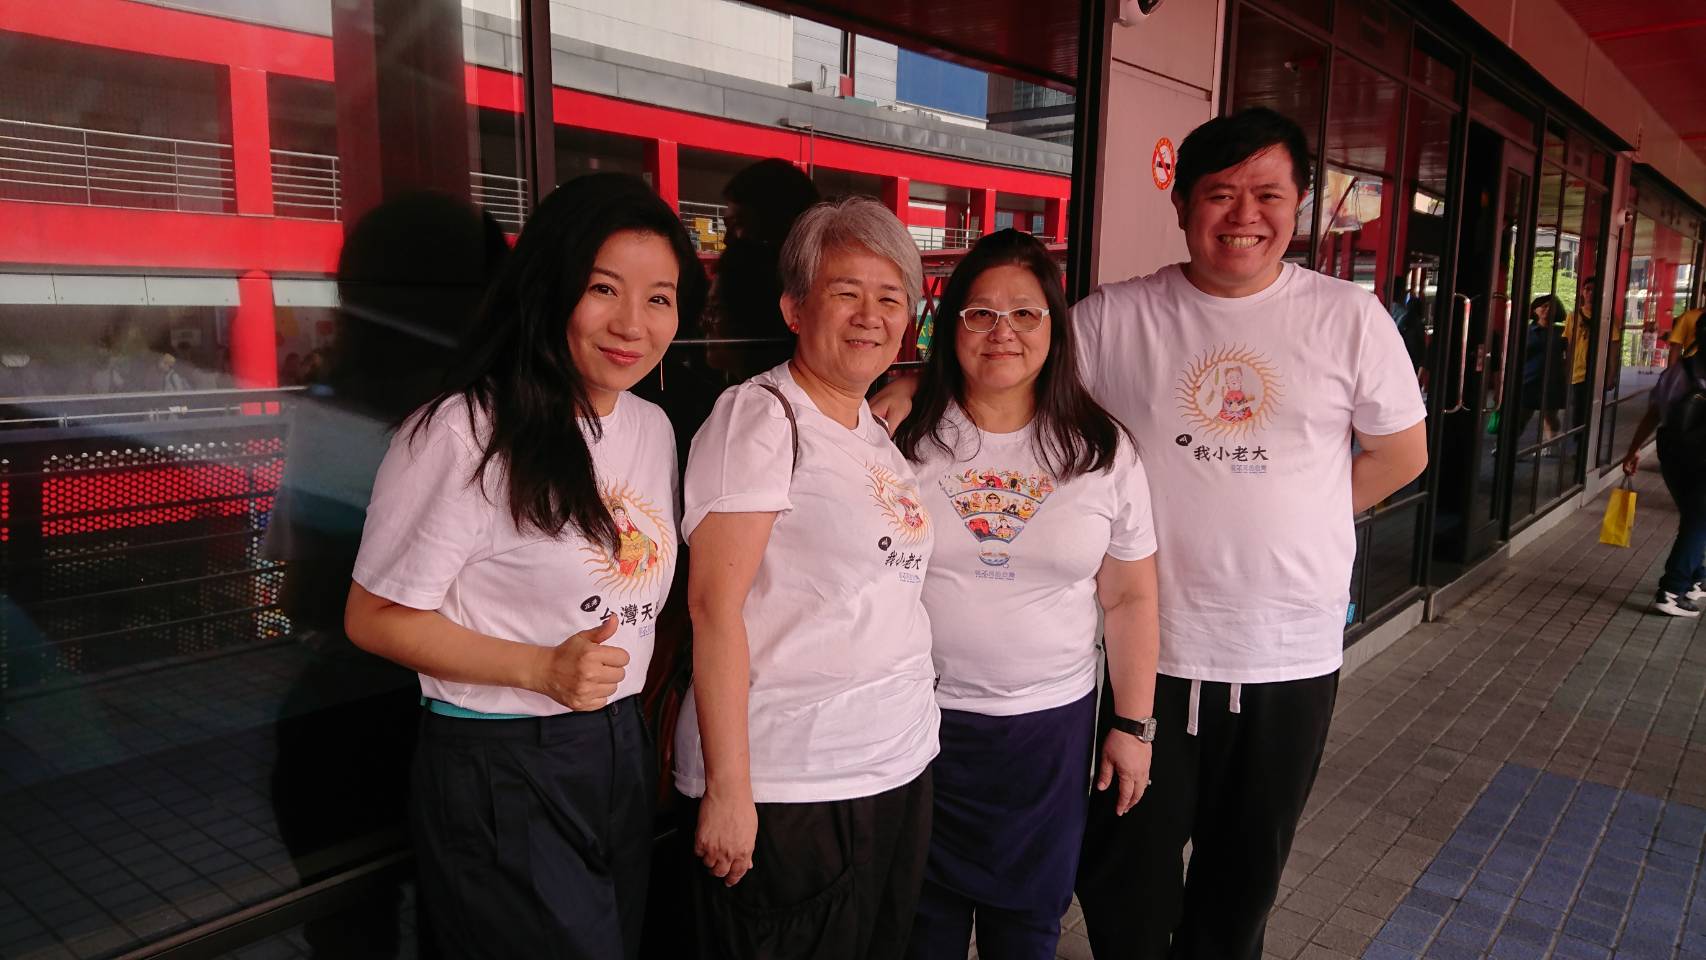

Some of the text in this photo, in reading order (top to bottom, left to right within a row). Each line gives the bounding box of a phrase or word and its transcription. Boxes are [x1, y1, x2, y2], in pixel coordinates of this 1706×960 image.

[1193, 444, 1269, 462] 我小老大
[885, 549, 922, 570] 我小老大
